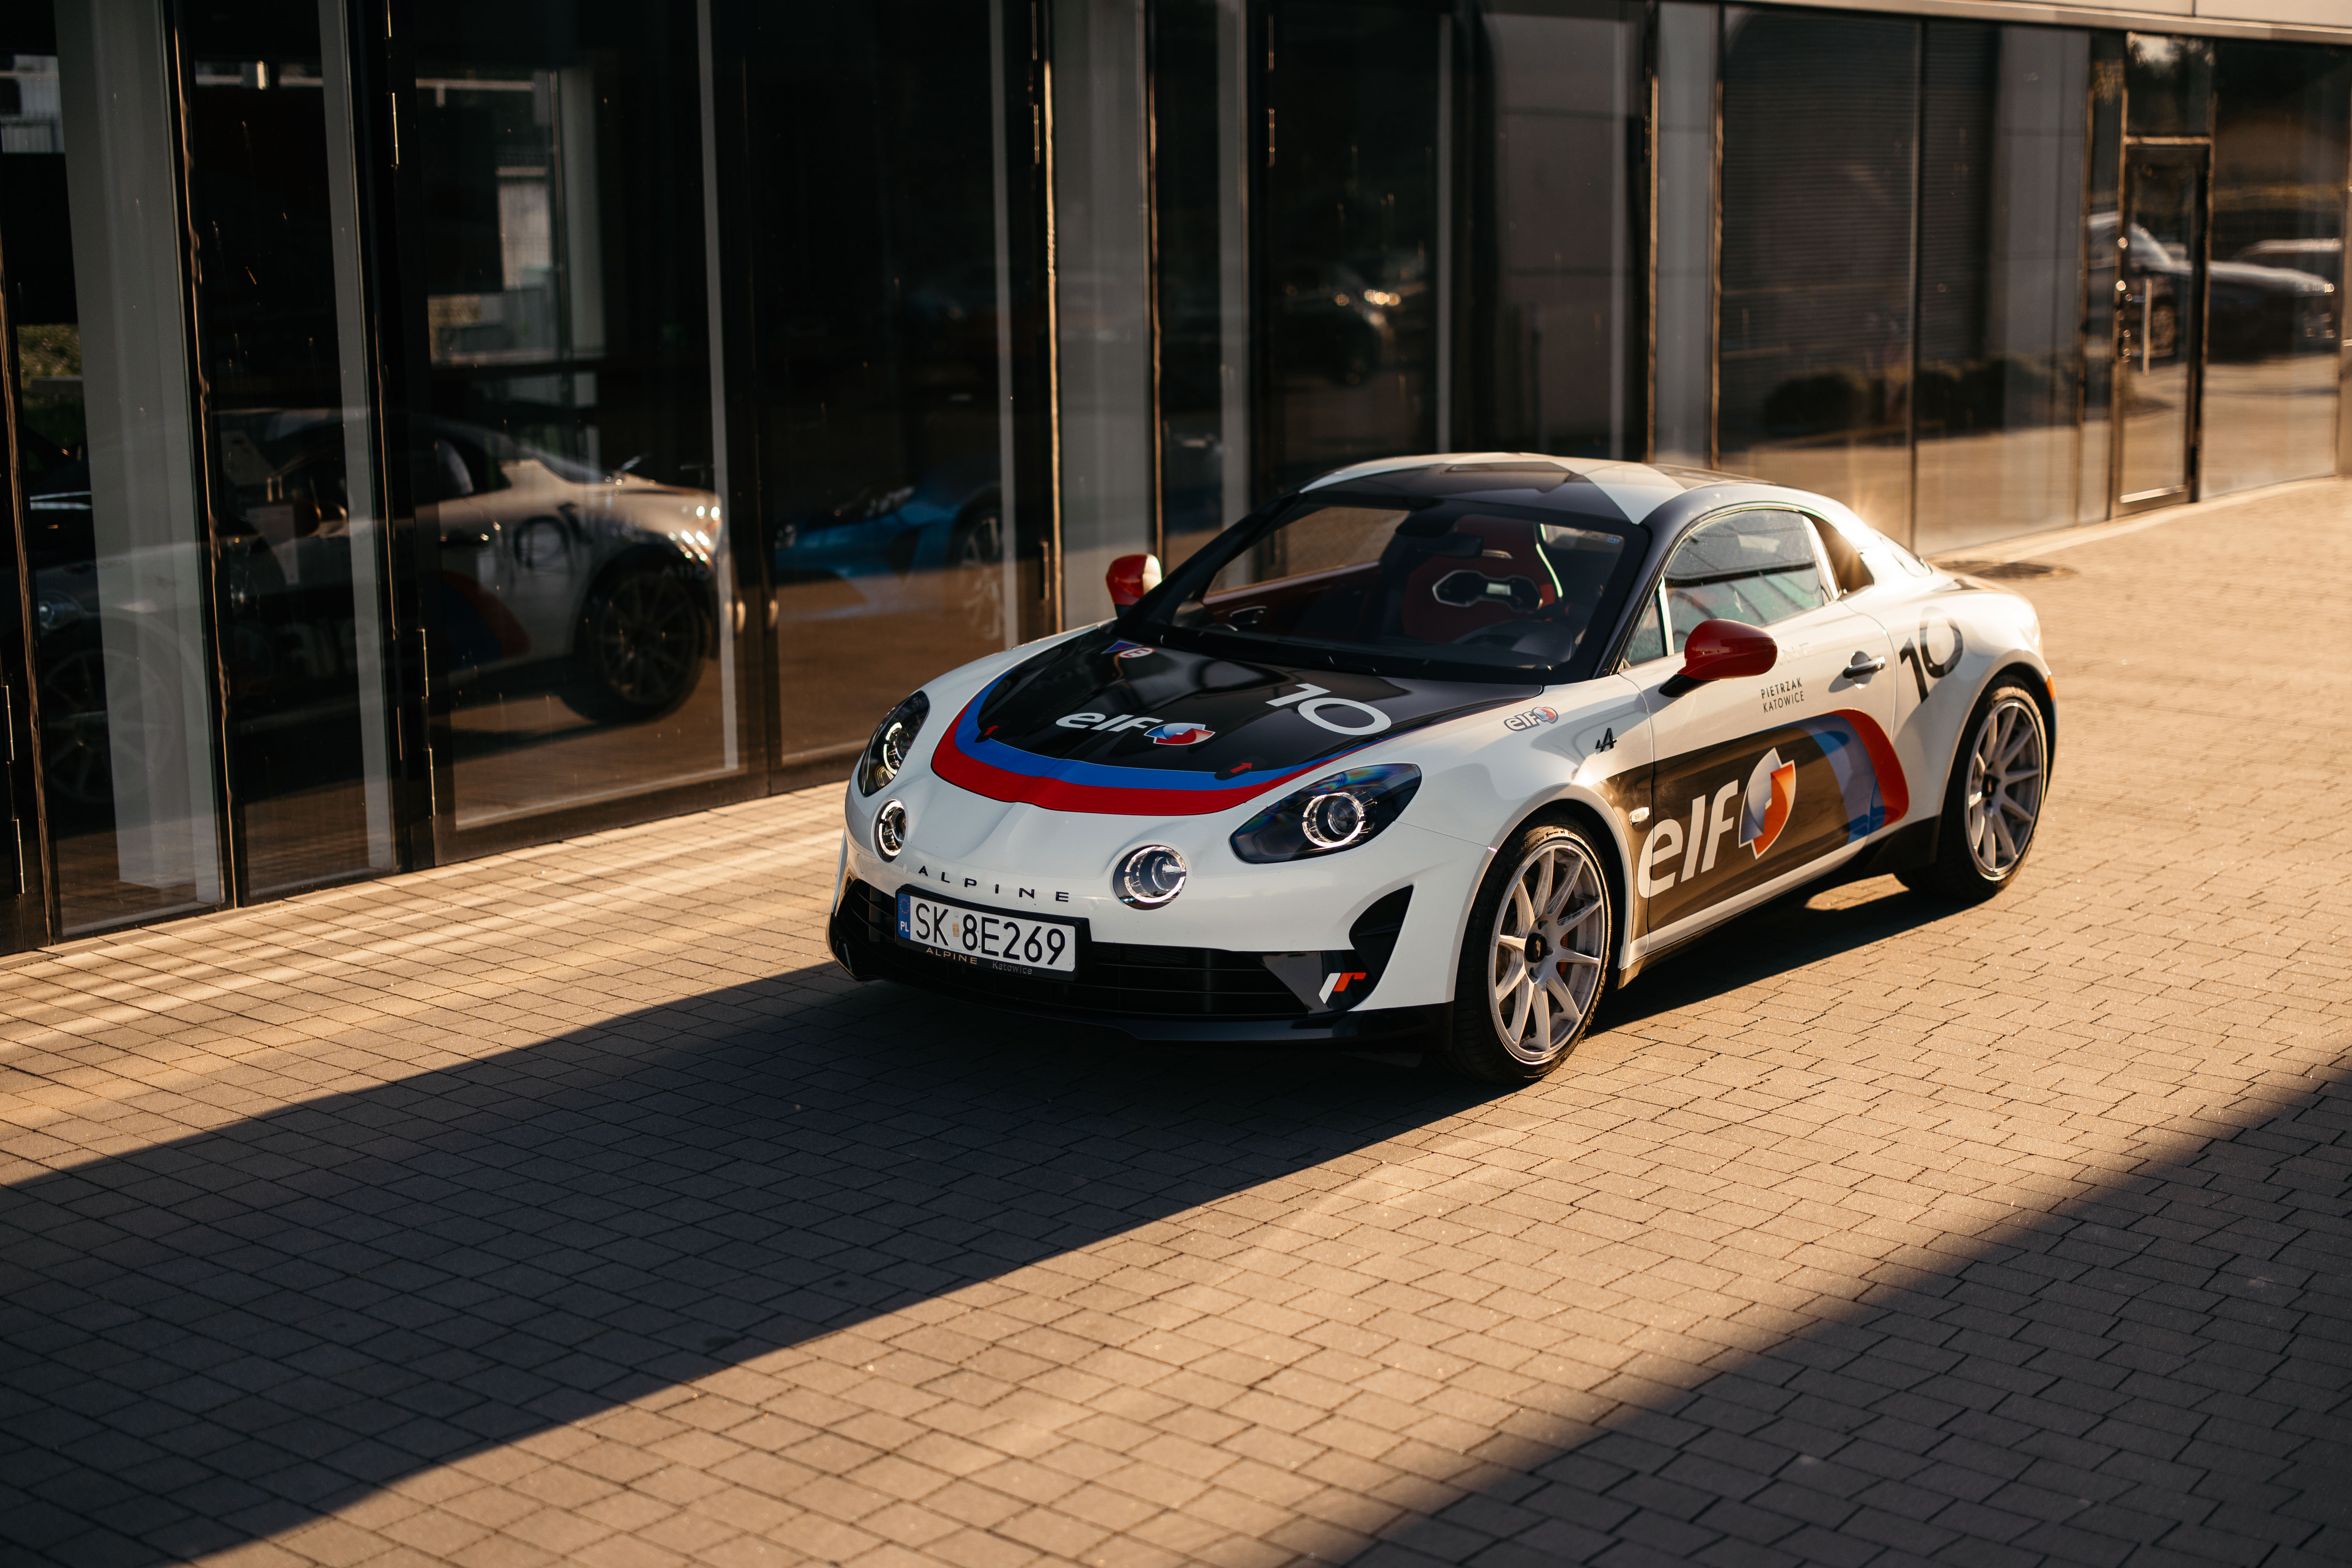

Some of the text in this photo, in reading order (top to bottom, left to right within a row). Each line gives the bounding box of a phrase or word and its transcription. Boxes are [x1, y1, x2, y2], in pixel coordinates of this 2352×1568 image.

[1899, 606, 1964, 704] 10
[1761, 677, 1802, 699] PIETRZAK
[1763, 691, 1804, 713] KATOWICE
[1056, 712, 1164, 732] elf
[1265, 683, 1392, 735] 10
[1505, 711, 1541, 730] elf
[1637, 779, 1738, 898] elf
[918, 865, 1069, 902] ALPINE
[900, 920, 910, 933] PL
[915, 902, 1065, 965] SK 8E269
[926, 947, 1033, 975] ALPINE Katowice
